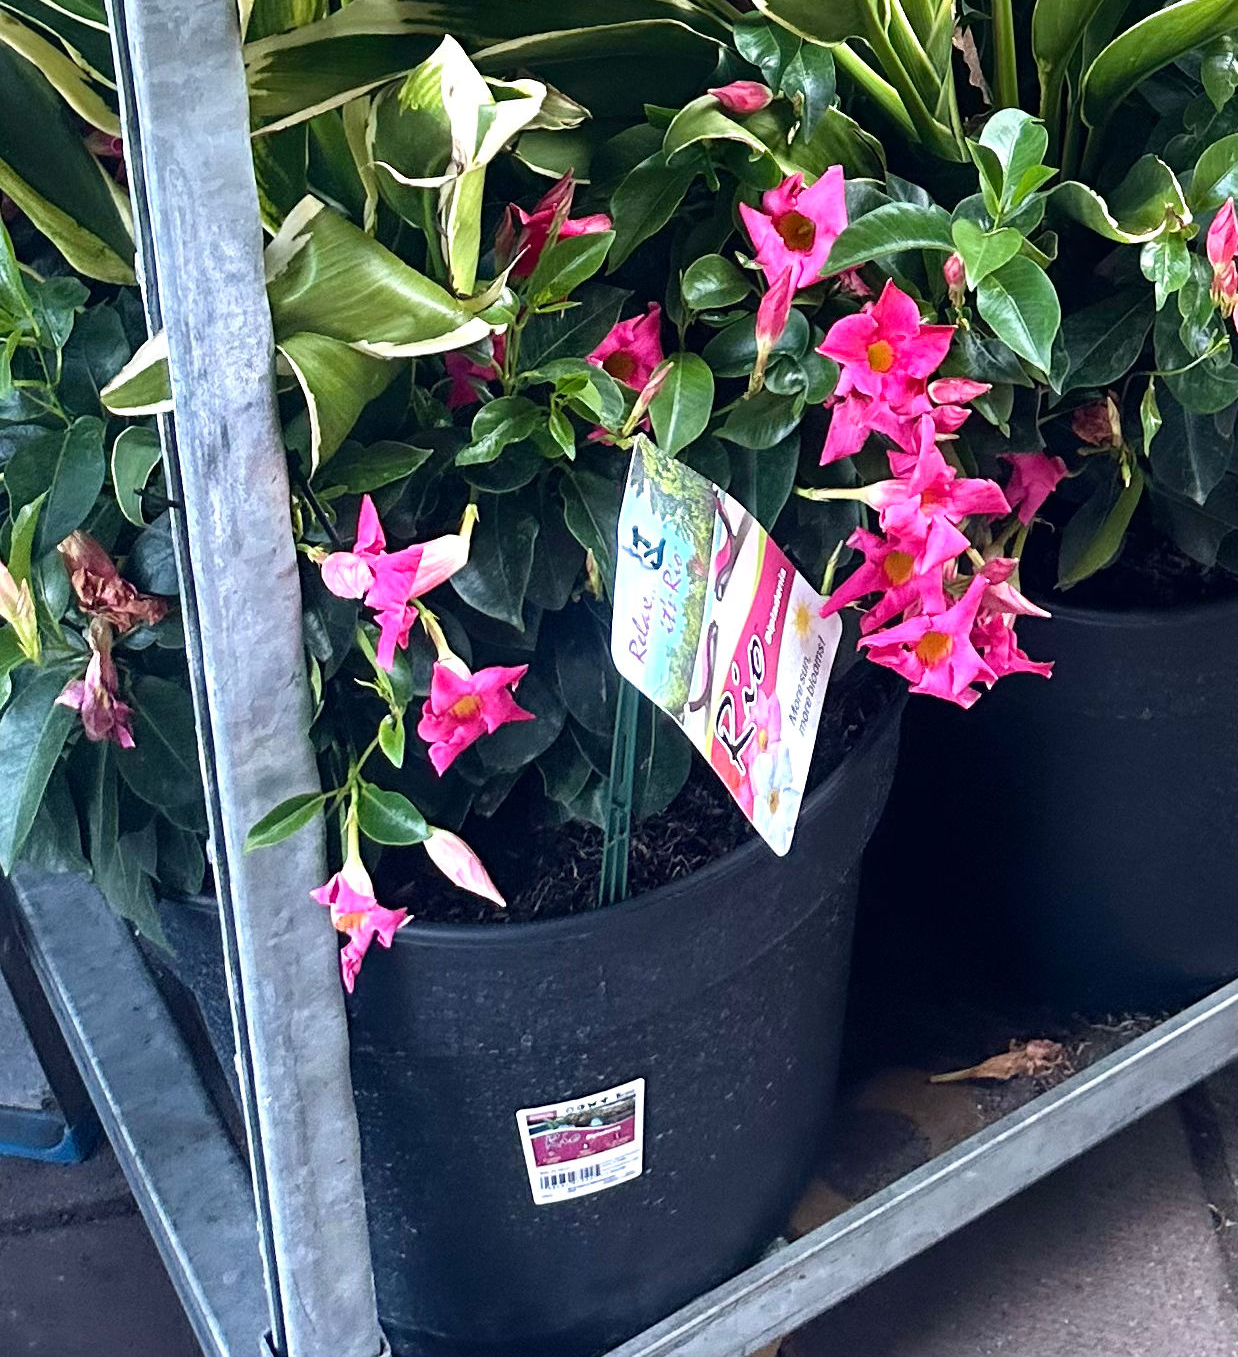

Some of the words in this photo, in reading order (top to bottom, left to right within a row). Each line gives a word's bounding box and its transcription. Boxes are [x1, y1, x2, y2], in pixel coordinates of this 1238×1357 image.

[714, 634, 765, 776] Rio
[789, 682, 804, 726] More
[799, 654, 812, 682] sun,
[799, 696, 814, 737] more
[810, 634, 827, 696] blooms!
